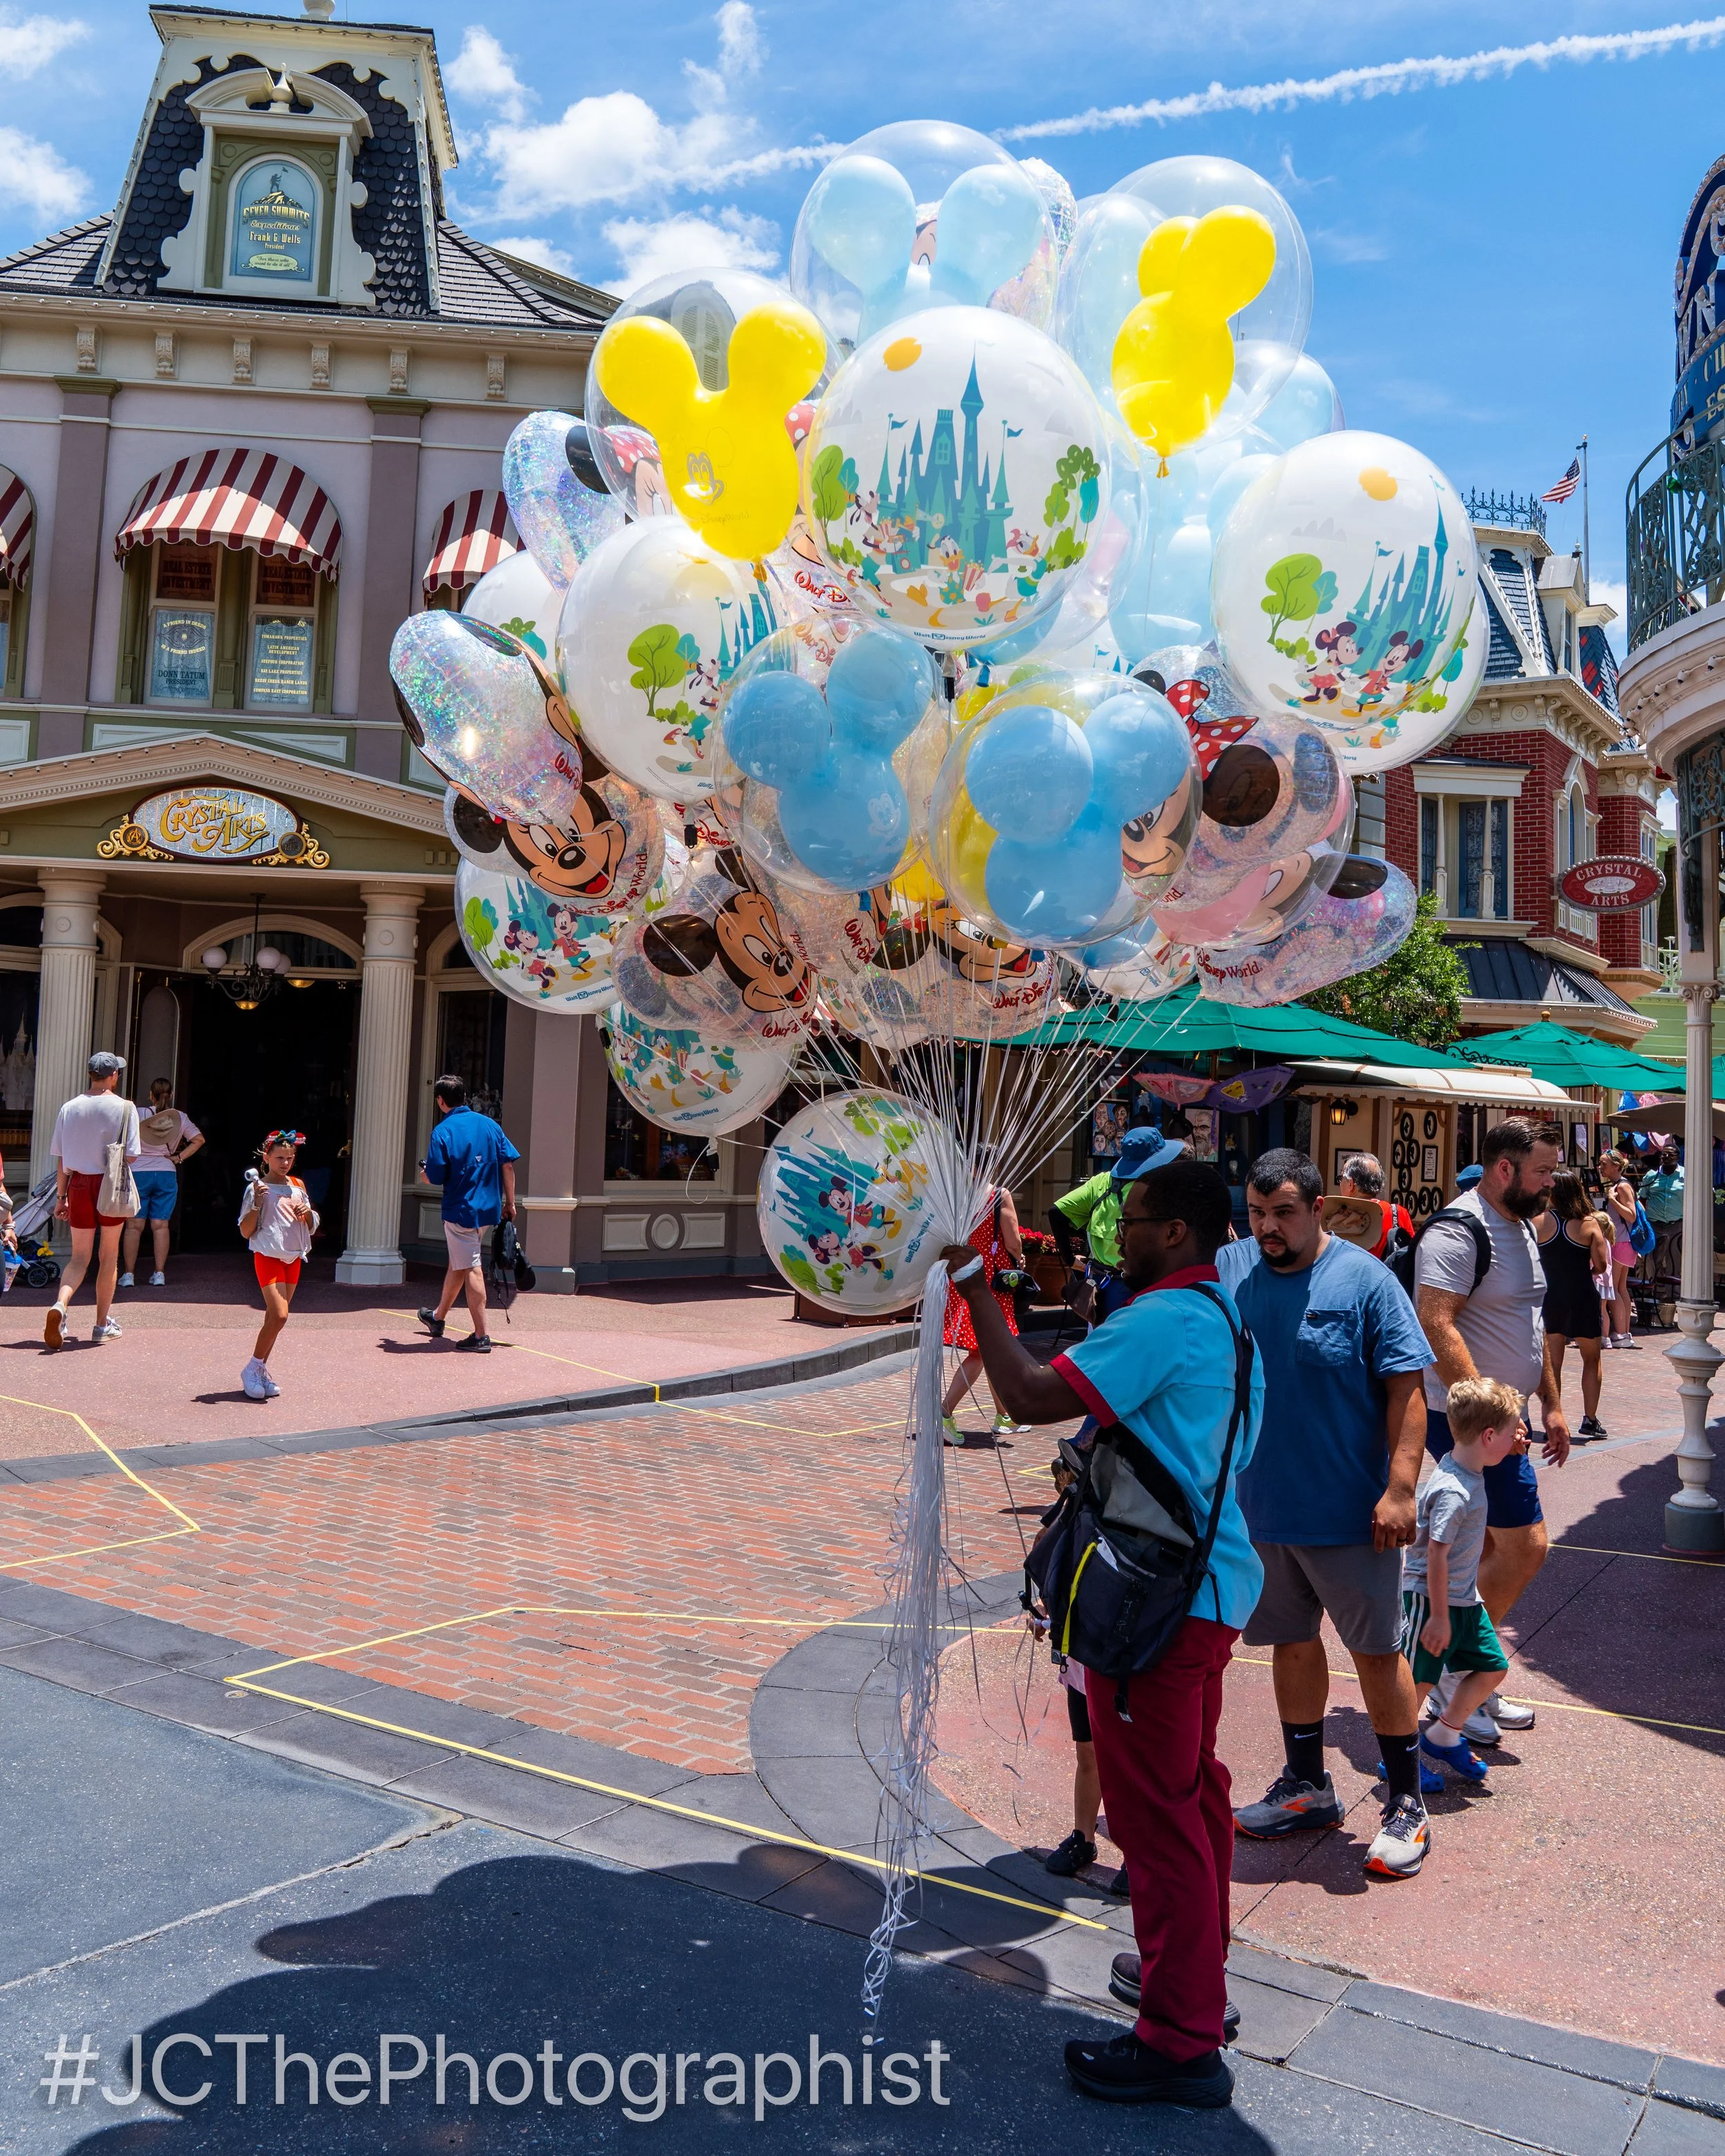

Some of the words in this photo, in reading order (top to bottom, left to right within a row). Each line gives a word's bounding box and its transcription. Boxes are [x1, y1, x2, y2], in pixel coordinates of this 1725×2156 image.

[243, 206, 269, 224] SEVEN
[271, 206, 310, 229] SUMMITS
[250, 219, 300, 230] Expeditions
[249, 231, 270, 241] Frank
[282, 234, 301, 244] Wells
[192, 621, 207, 629] DEEDS
[188, 646, 206, 654] INDEED
[158, 669, 178, 678] DONN
[180, 671, 206, 680] TATUM
[160, 792, 244, 842] CRYSTAL
[193, 812, 270, 854] ARTS
[1576, 864, 1642, 881] CRYSTAL
[1590, 894, 1630, 907] ARTS
[1225, 961, 1260, 979] World
[703, 1107, 719, 1116] World
